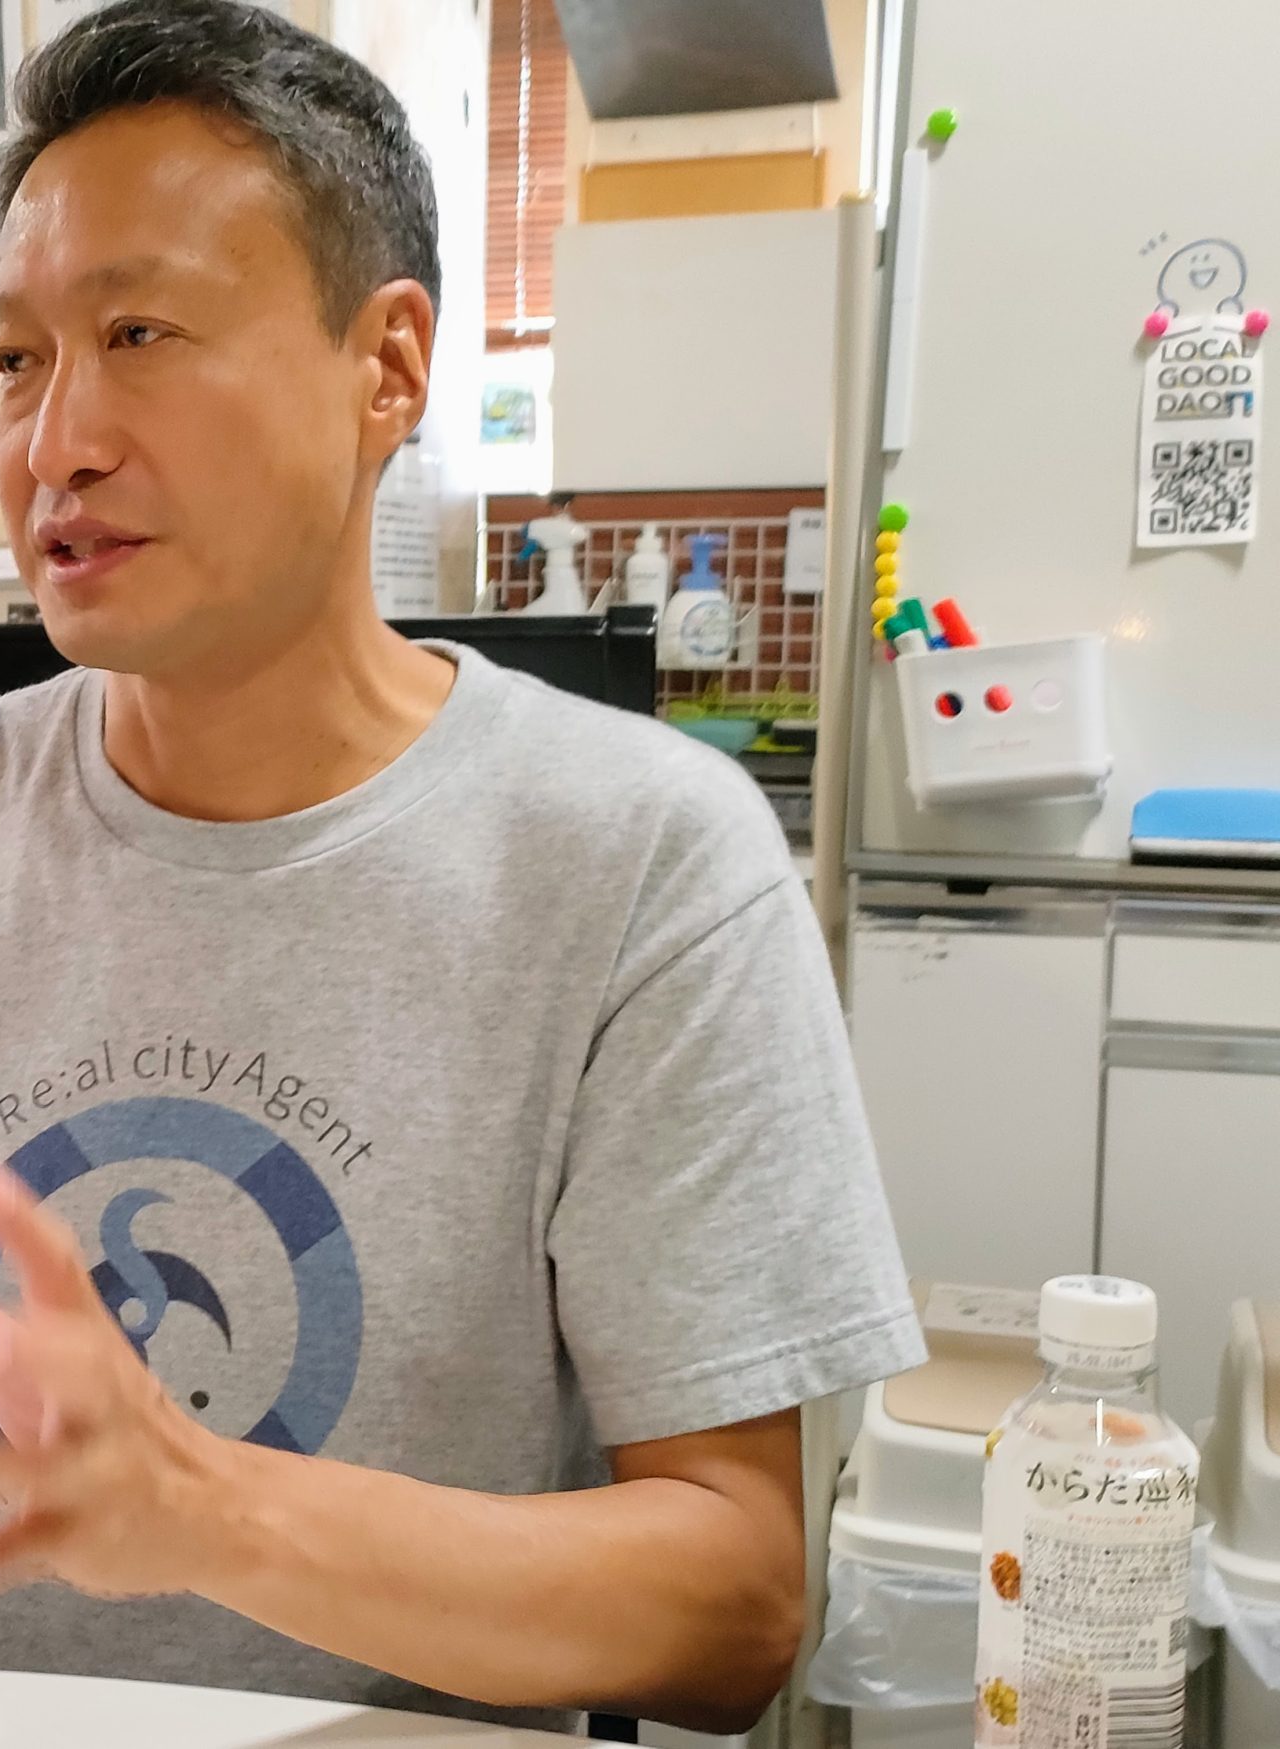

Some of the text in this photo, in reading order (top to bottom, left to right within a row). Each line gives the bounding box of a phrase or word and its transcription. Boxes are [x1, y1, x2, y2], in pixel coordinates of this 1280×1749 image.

[1160, 338, 1255, 363] LOCAL
[1157, 364, 1252, 389] GOOD
[132, 1035, 230, 1093] city
[232, 1050, 374, 1176] Agent
